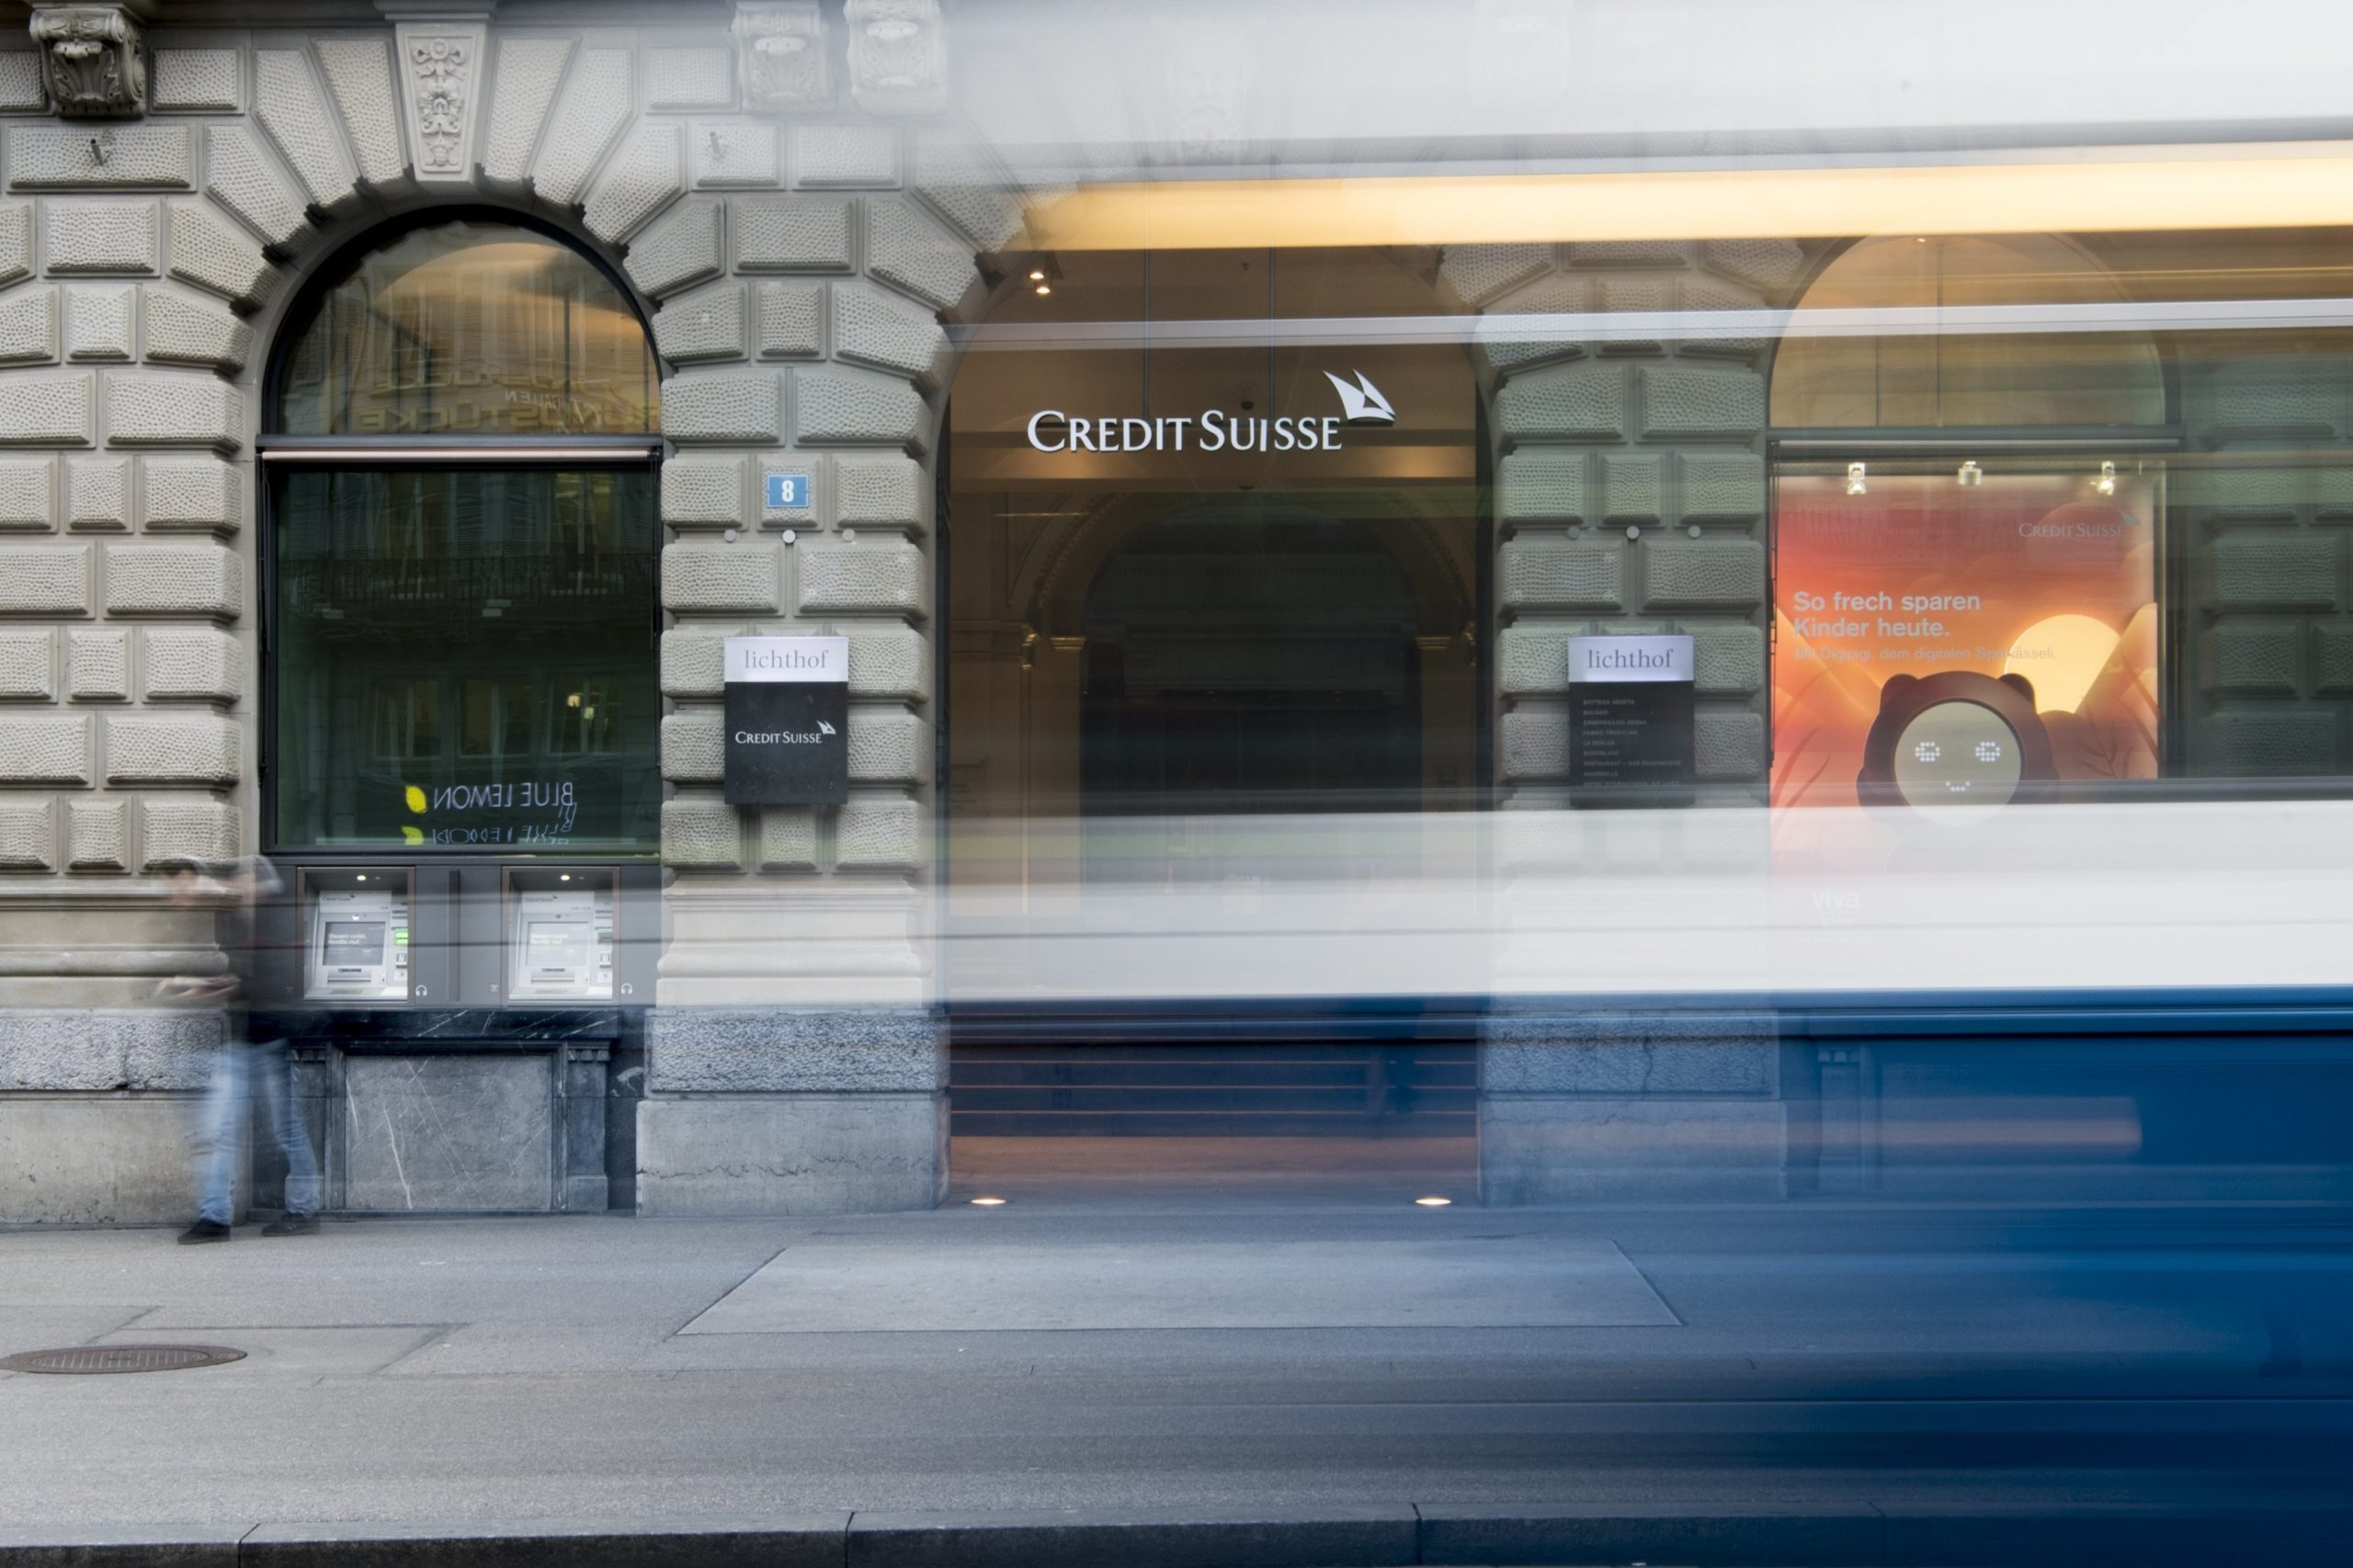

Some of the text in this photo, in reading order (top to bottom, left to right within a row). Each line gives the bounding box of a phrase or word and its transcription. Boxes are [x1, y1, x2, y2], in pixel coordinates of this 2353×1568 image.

[1027, 409, 1343, 452] CREDIT SUISSE
[781, 479, 794, 503] 8
[2018, 522, 2125, 538] CREDIT SUISSE
[1793, 590, 1981, 615] So frech sparen
[1793, 617, 1950, 637] Kinder heute.
[745, 650, 829, 669] lichthof
[1587, 648, 1675, 669] lichthof
[1880, 646, 1910, 660] dem
[1915, 646, 1972, 663] digitalen
[734, 731, 823, 744] CREDIT SUISSE
[1812, 885, 1860, 908] viva
